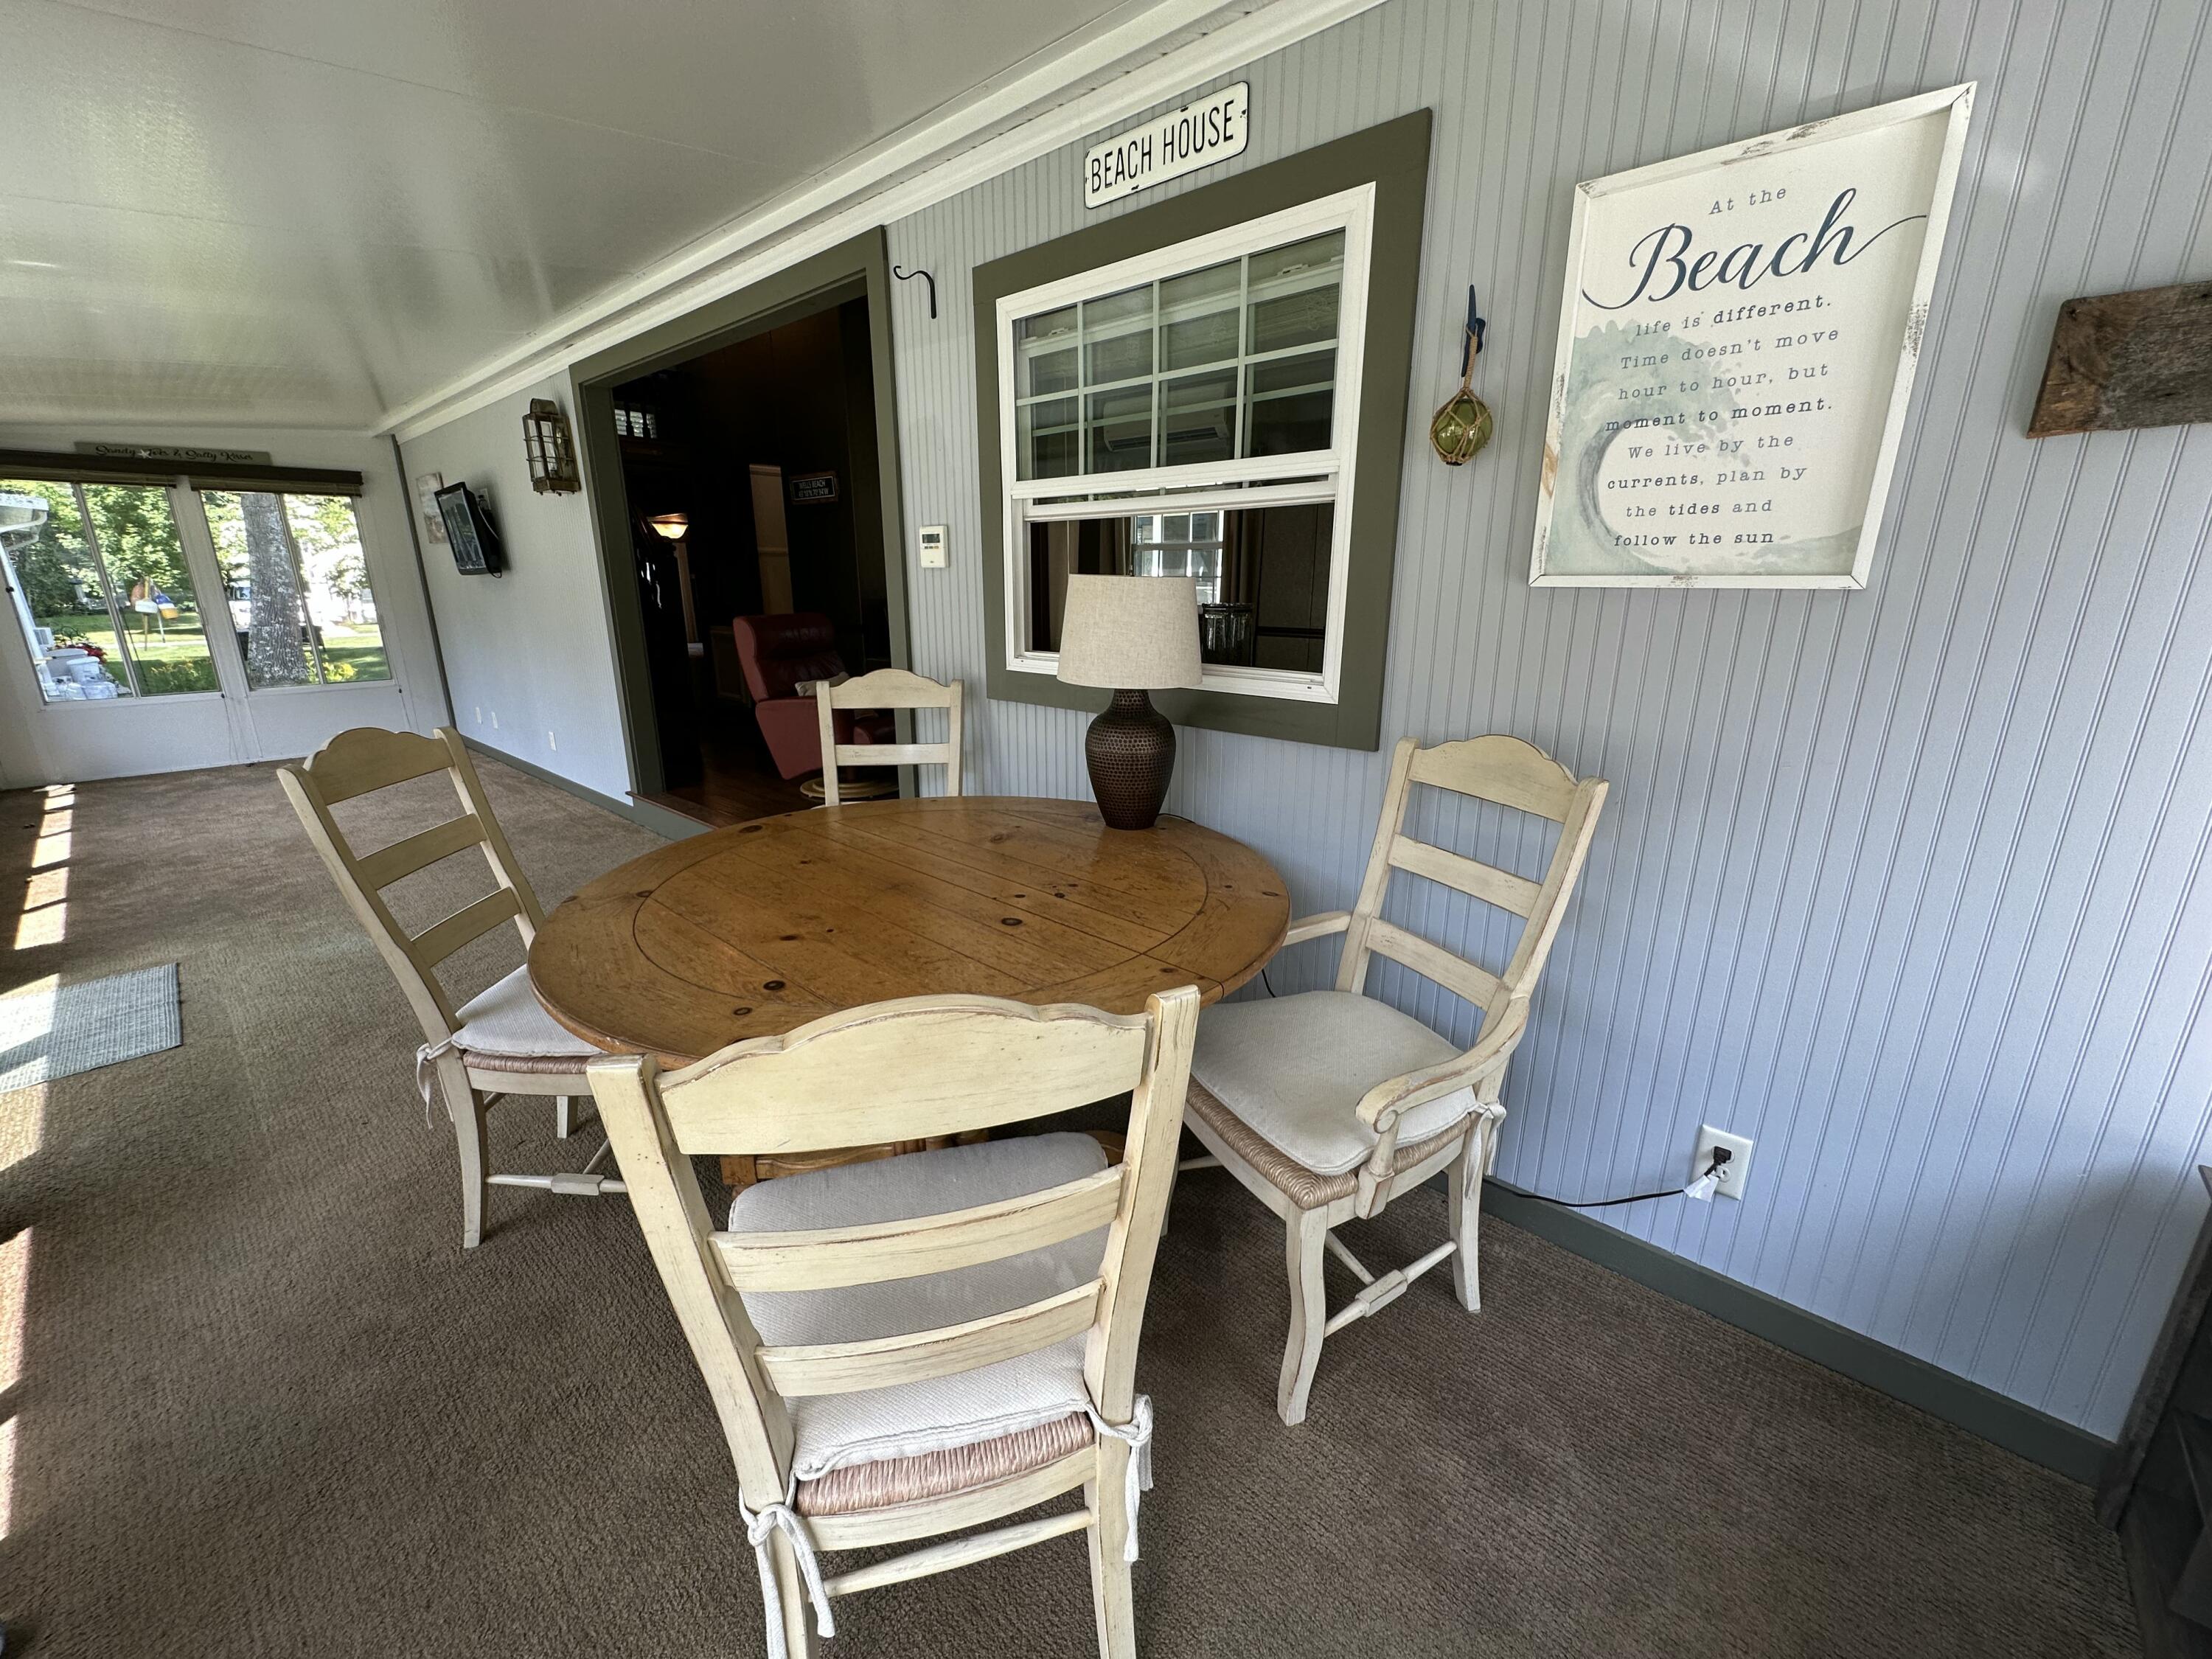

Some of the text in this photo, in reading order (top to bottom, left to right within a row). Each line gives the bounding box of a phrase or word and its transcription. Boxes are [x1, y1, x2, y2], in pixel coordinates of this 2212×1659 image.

[1091, 99, 1234, 194] BEACH HOUSE
[1708, 187, 1787, 215] At the
[1582, 187, 1927, 310] Beach
[1635, 295, 1831, 337] life is different.
[1620, 329, 1839, 369] Time doesn't move
[1617, 364, 1829, 400] hour to hour, but
[1604, 397, 1833, 432] moment to moment.
[95, 445, 136, 459] Sandy
[185, 450, 217, 462] Salty
[220, 451, 254, 462] Kisses
[1627, 435, 1795, 459] We live by the
[1607, 467, 1808, 490] currents, plan by
[1625, 499, 1773, 518] the tides and
[1613, 532, 1775, 547] follow the sun
